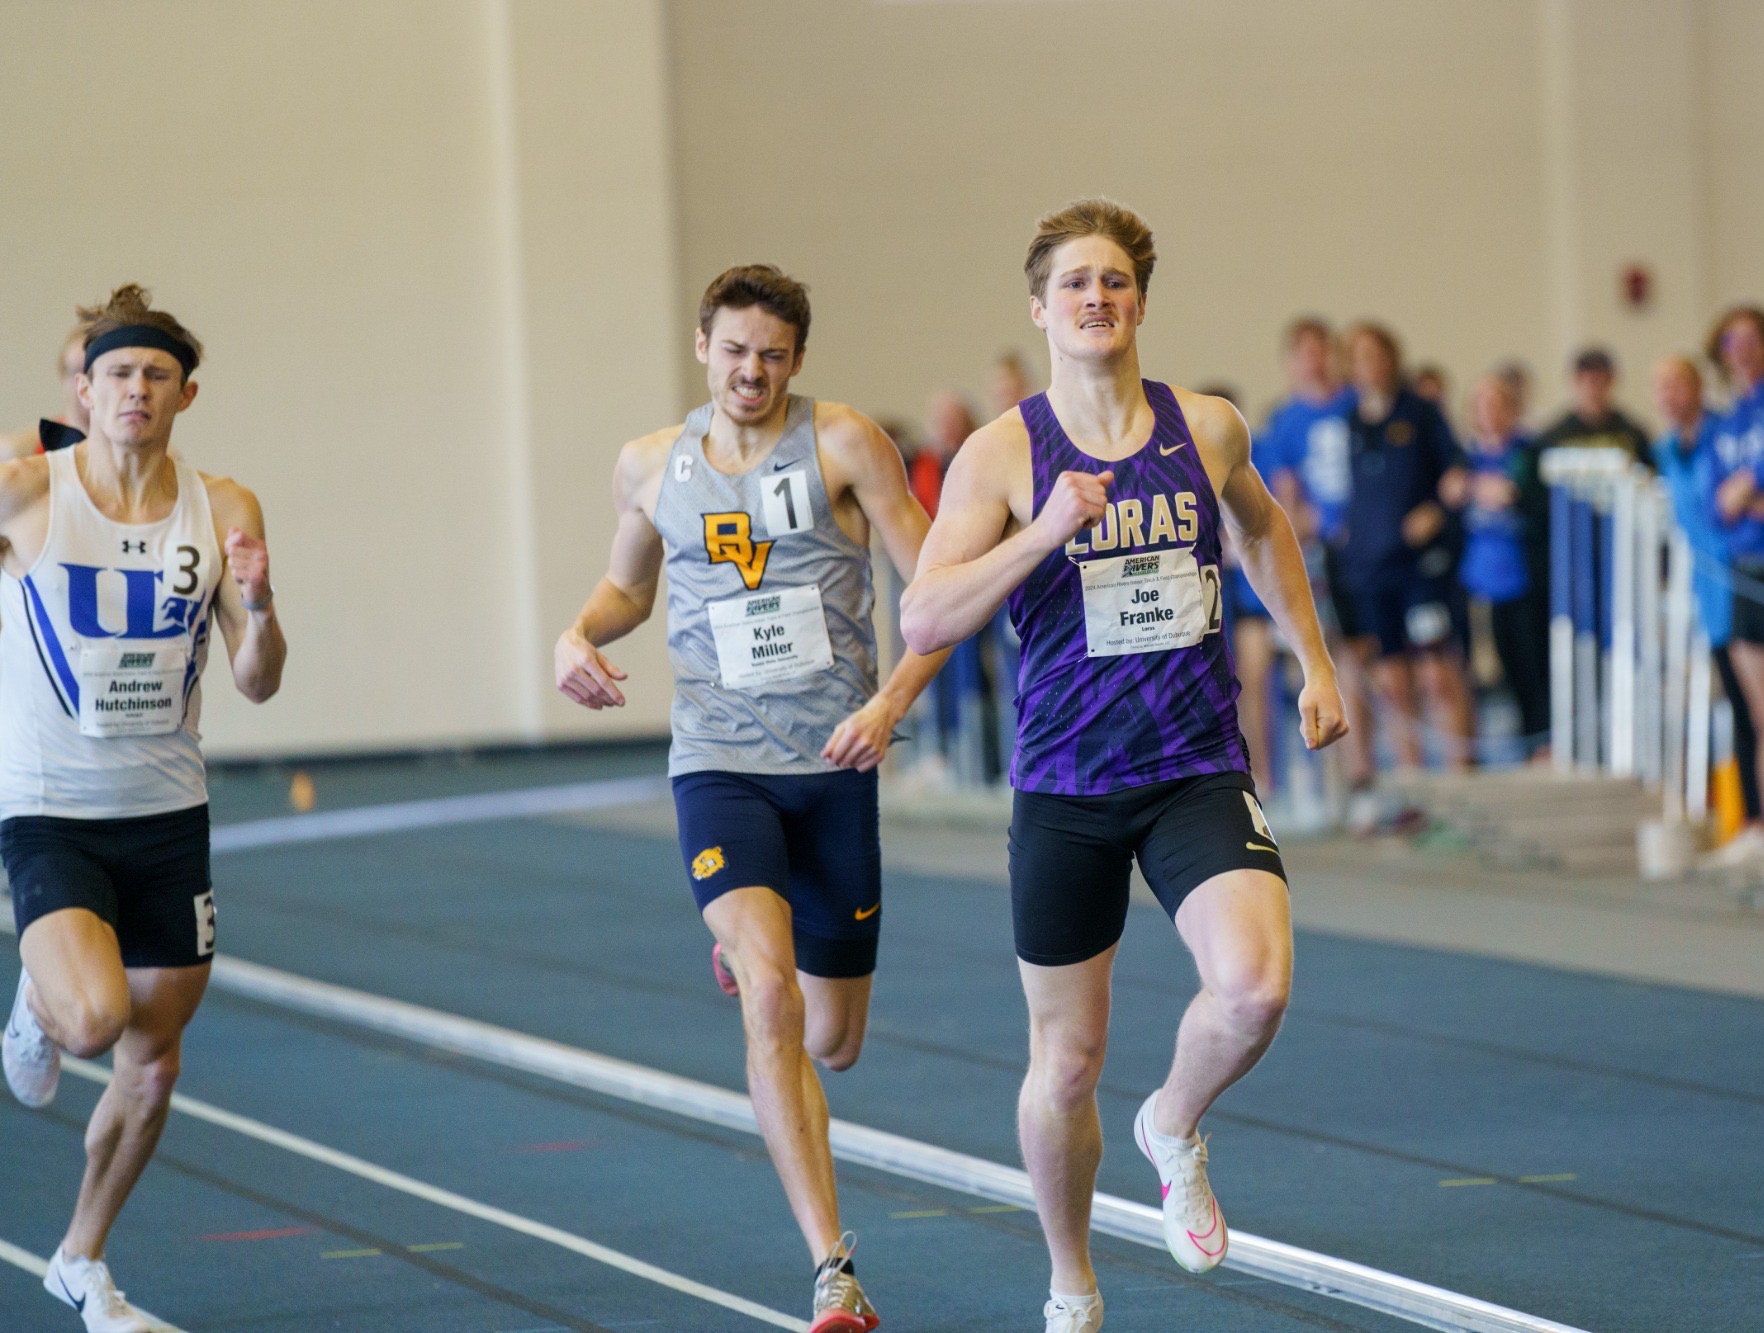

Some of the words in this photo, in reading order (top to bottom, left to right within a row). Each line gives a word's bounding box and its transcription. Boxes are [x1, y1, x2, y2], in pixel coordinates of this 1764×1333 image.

[674, 454, 694, 483] C
[773, 477, 798, 530] 1
[1125, 554, 1160, 565] AMERICAN
[173, 545, 200, 595] 3
[1131, 588, 1160, 604] Joe
[1205, 569, 1221, 630] 2
[1120, 607, 1174, 626] Franke
[753, 625, 785, 641] Kyle
[1135, 634, 1161, 643] University
[751, 642, 793, 659] Miller
[109, 680, 162, 693] Andrew
[95, 697, 172, 712] Hutchinson
